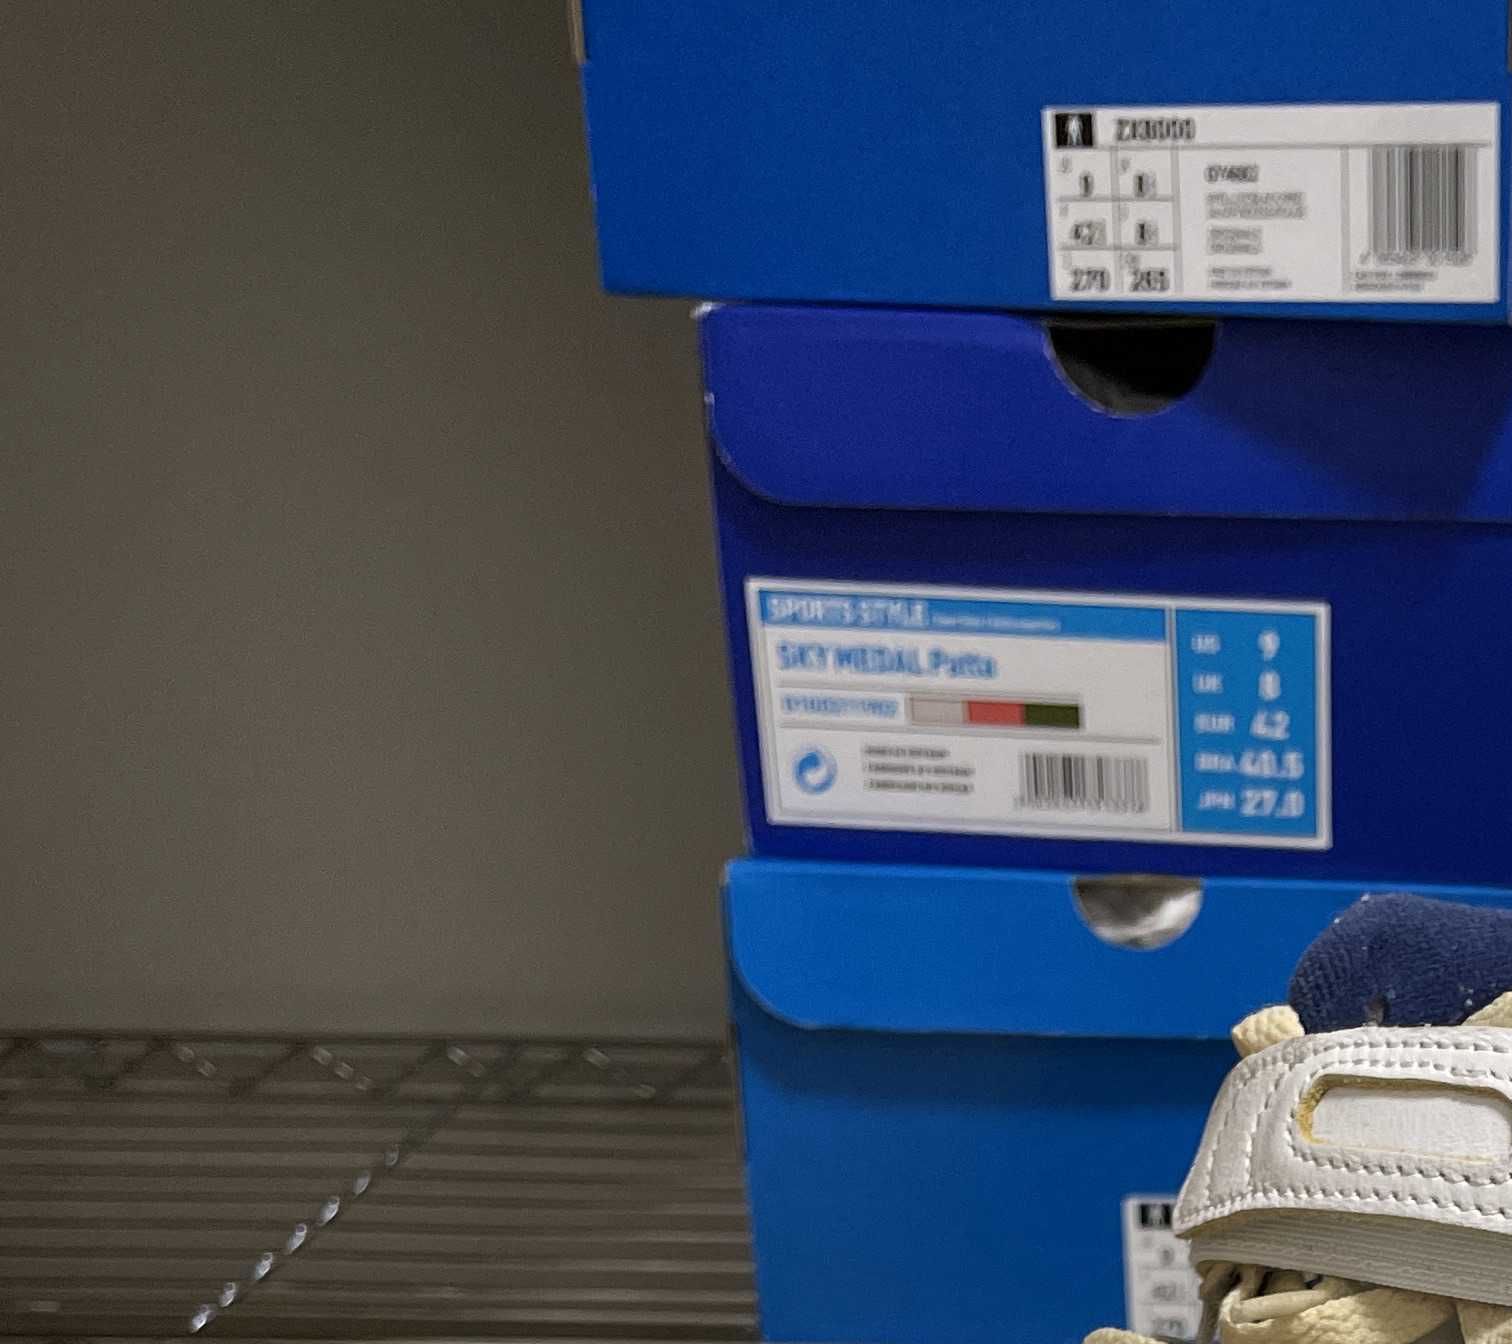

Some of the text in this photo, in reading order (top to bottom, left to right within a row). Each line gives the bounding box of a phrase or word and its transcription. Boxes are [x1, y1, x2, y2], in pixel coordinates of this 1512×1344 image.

[777, 639, 828, 670] SKY
[835, 645, 922, 675] MEDAL
[1257, 629, 1281, 661] 9
[1259, 669, 1283, 702] 8
[1250, 709, 1291, 741] 42
